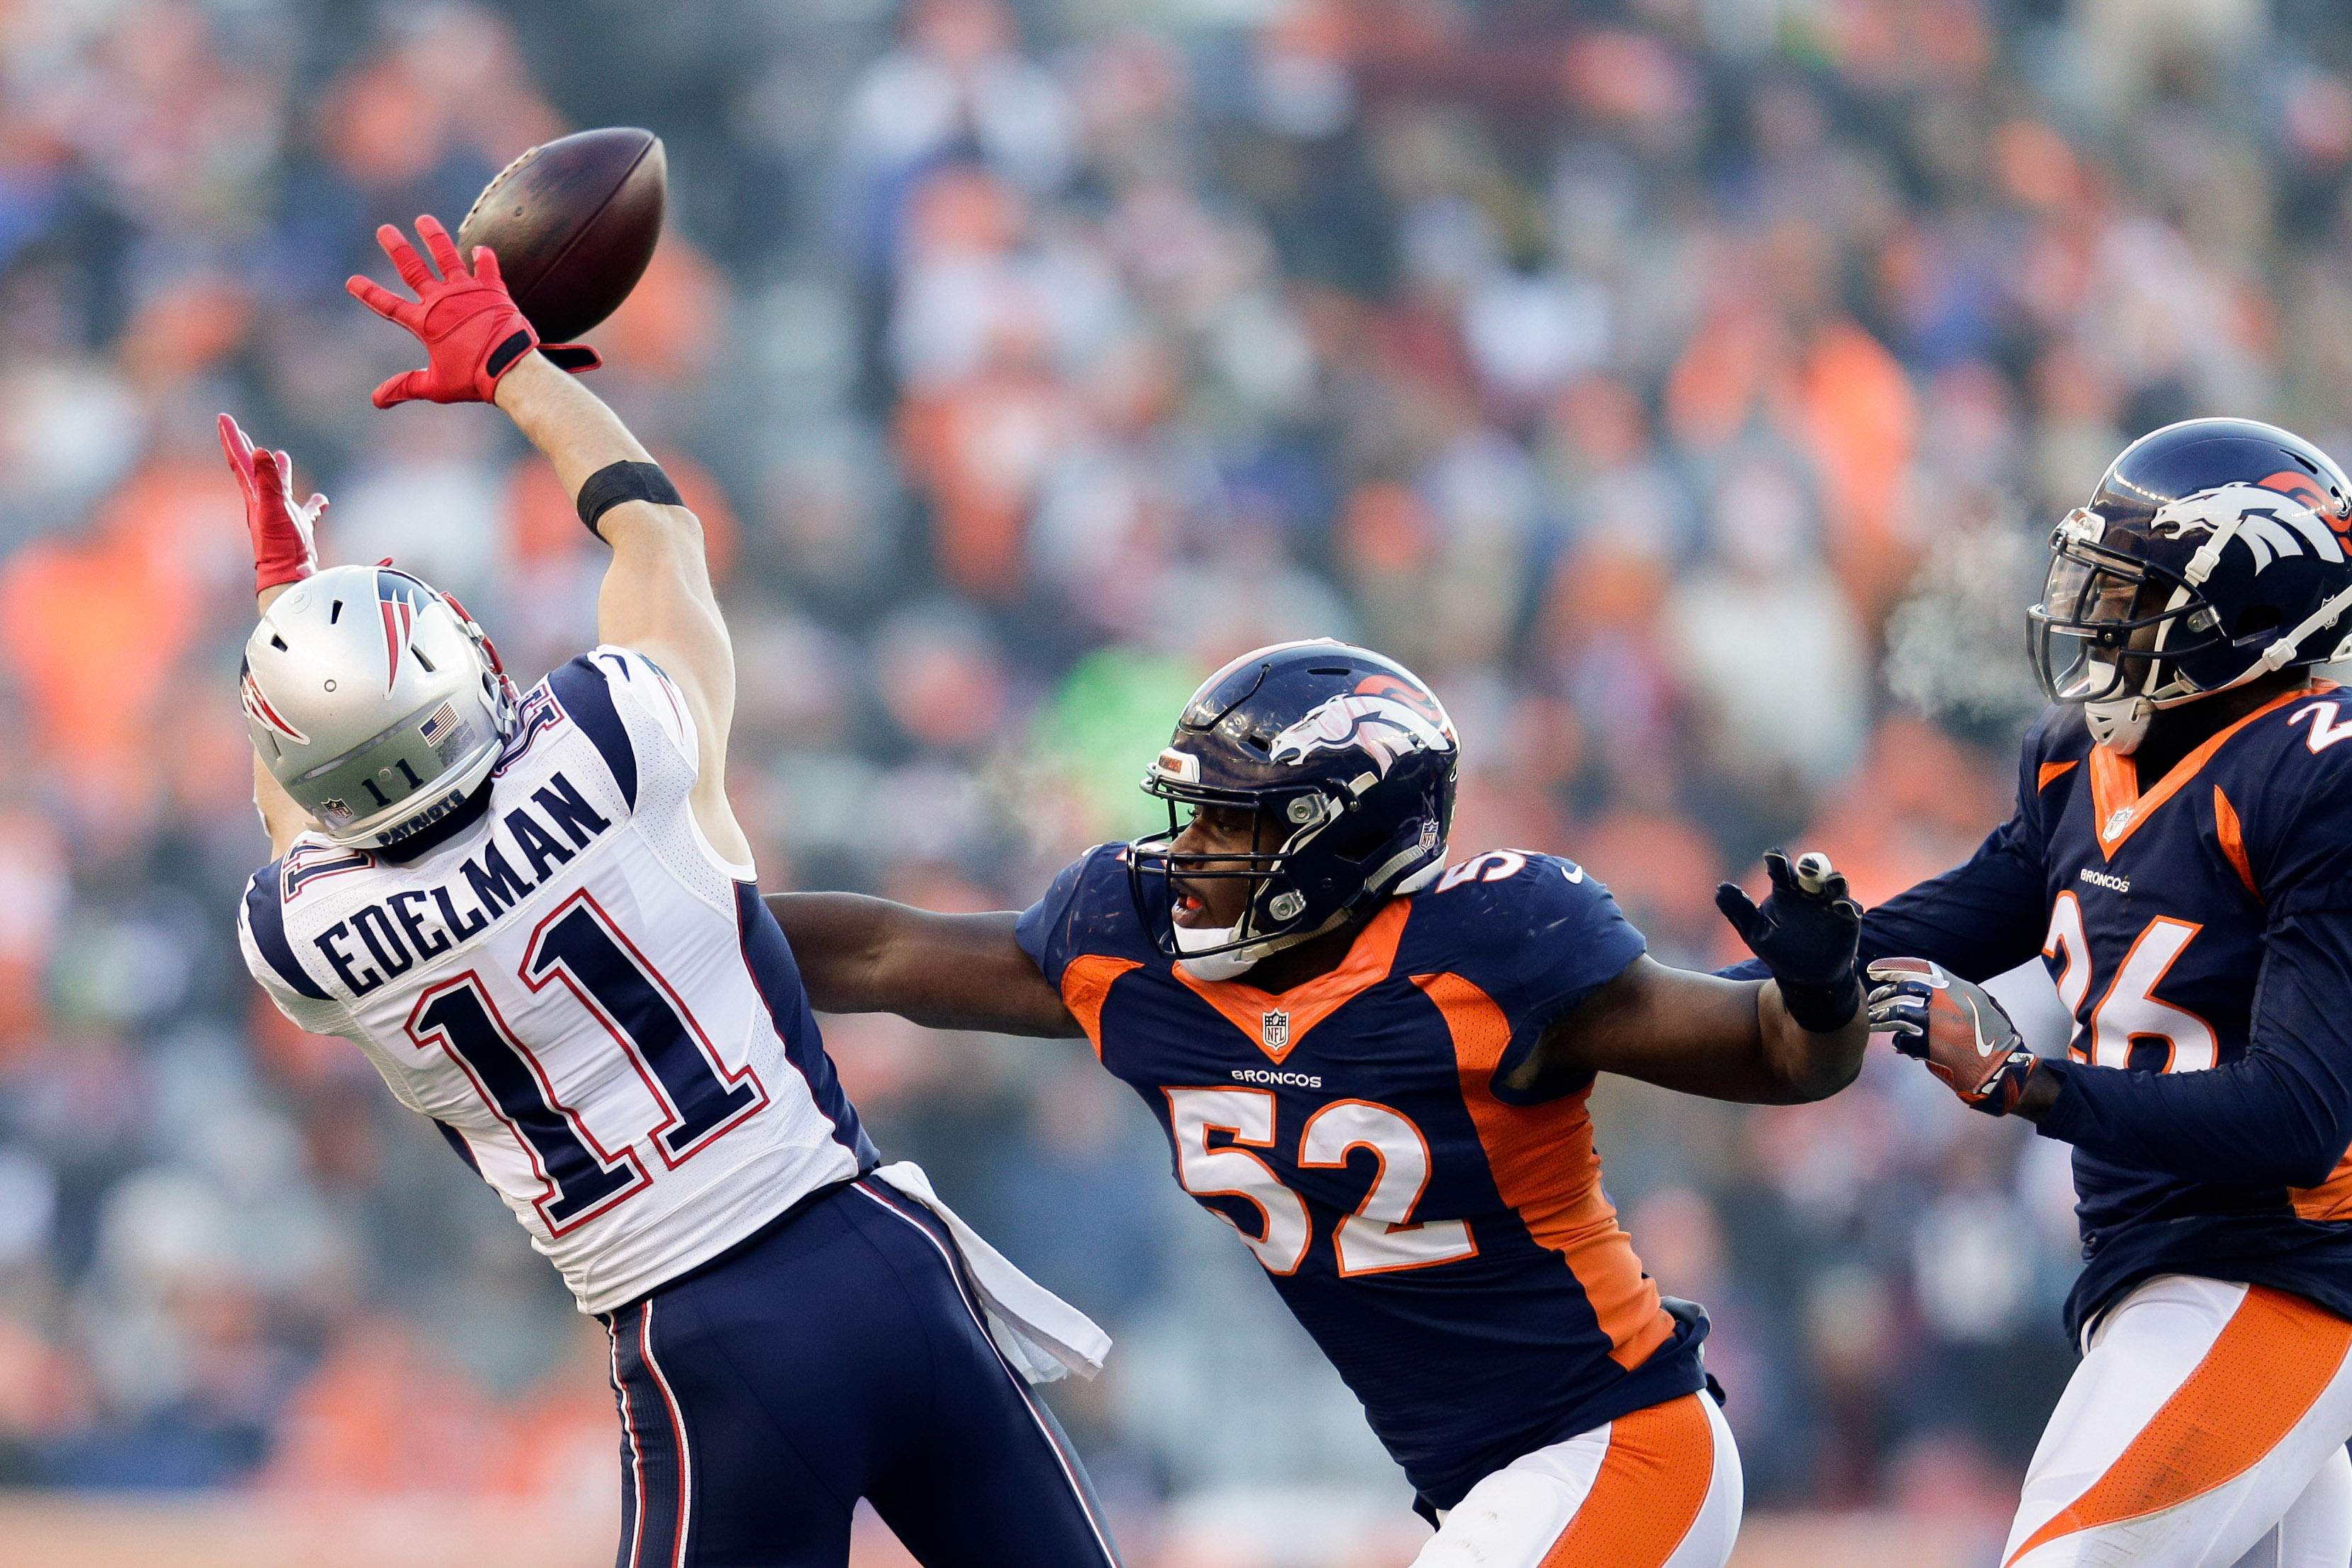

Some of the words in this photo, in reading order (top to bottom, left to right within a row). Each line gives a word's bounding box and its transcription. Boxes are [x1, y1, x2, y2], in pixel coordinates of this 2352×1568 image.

[362, 759, 424, 807] 11
[375, 788, 467, 847] PATRIOTS
[315, 771, 610, 997] EDELMAN
[2080, 868, 2131, 893] BRONCOS
[2041, 890, 2218, 1074] 26
[403, 887, 769, 1239] 11
[1267, 1027, 1285, 1043] NFL
[1231, 1069, 1322, 1089] BRONCOS
[1159, 1085, 1479, 1278] 52
